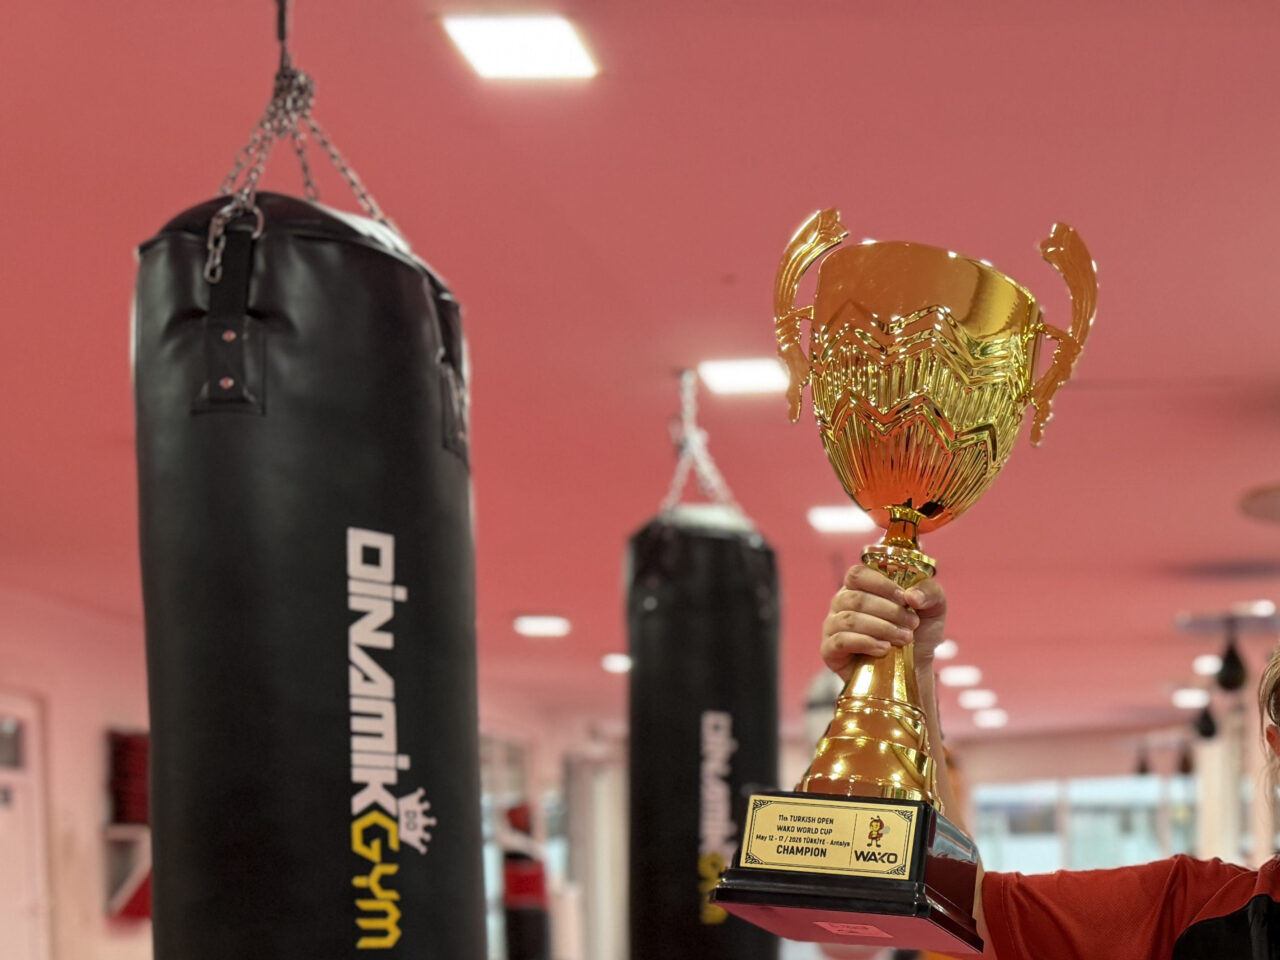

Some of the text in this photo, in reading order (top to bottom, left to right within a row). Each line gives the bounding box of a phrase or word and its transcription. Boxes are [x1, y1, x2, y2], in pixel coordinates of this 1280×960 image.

[789, 815, 816, 824] TURKISH
[817, 817, 834, 825] OPEN
[777, 825, 833, 836] WAKO WORLD CUP
[756, 834, 767, 842] May
[830, 840, 850, 848] Antalya
[776, 844, 827, 858] CHAMPION
[854, 850, 898, 864] WAKO
